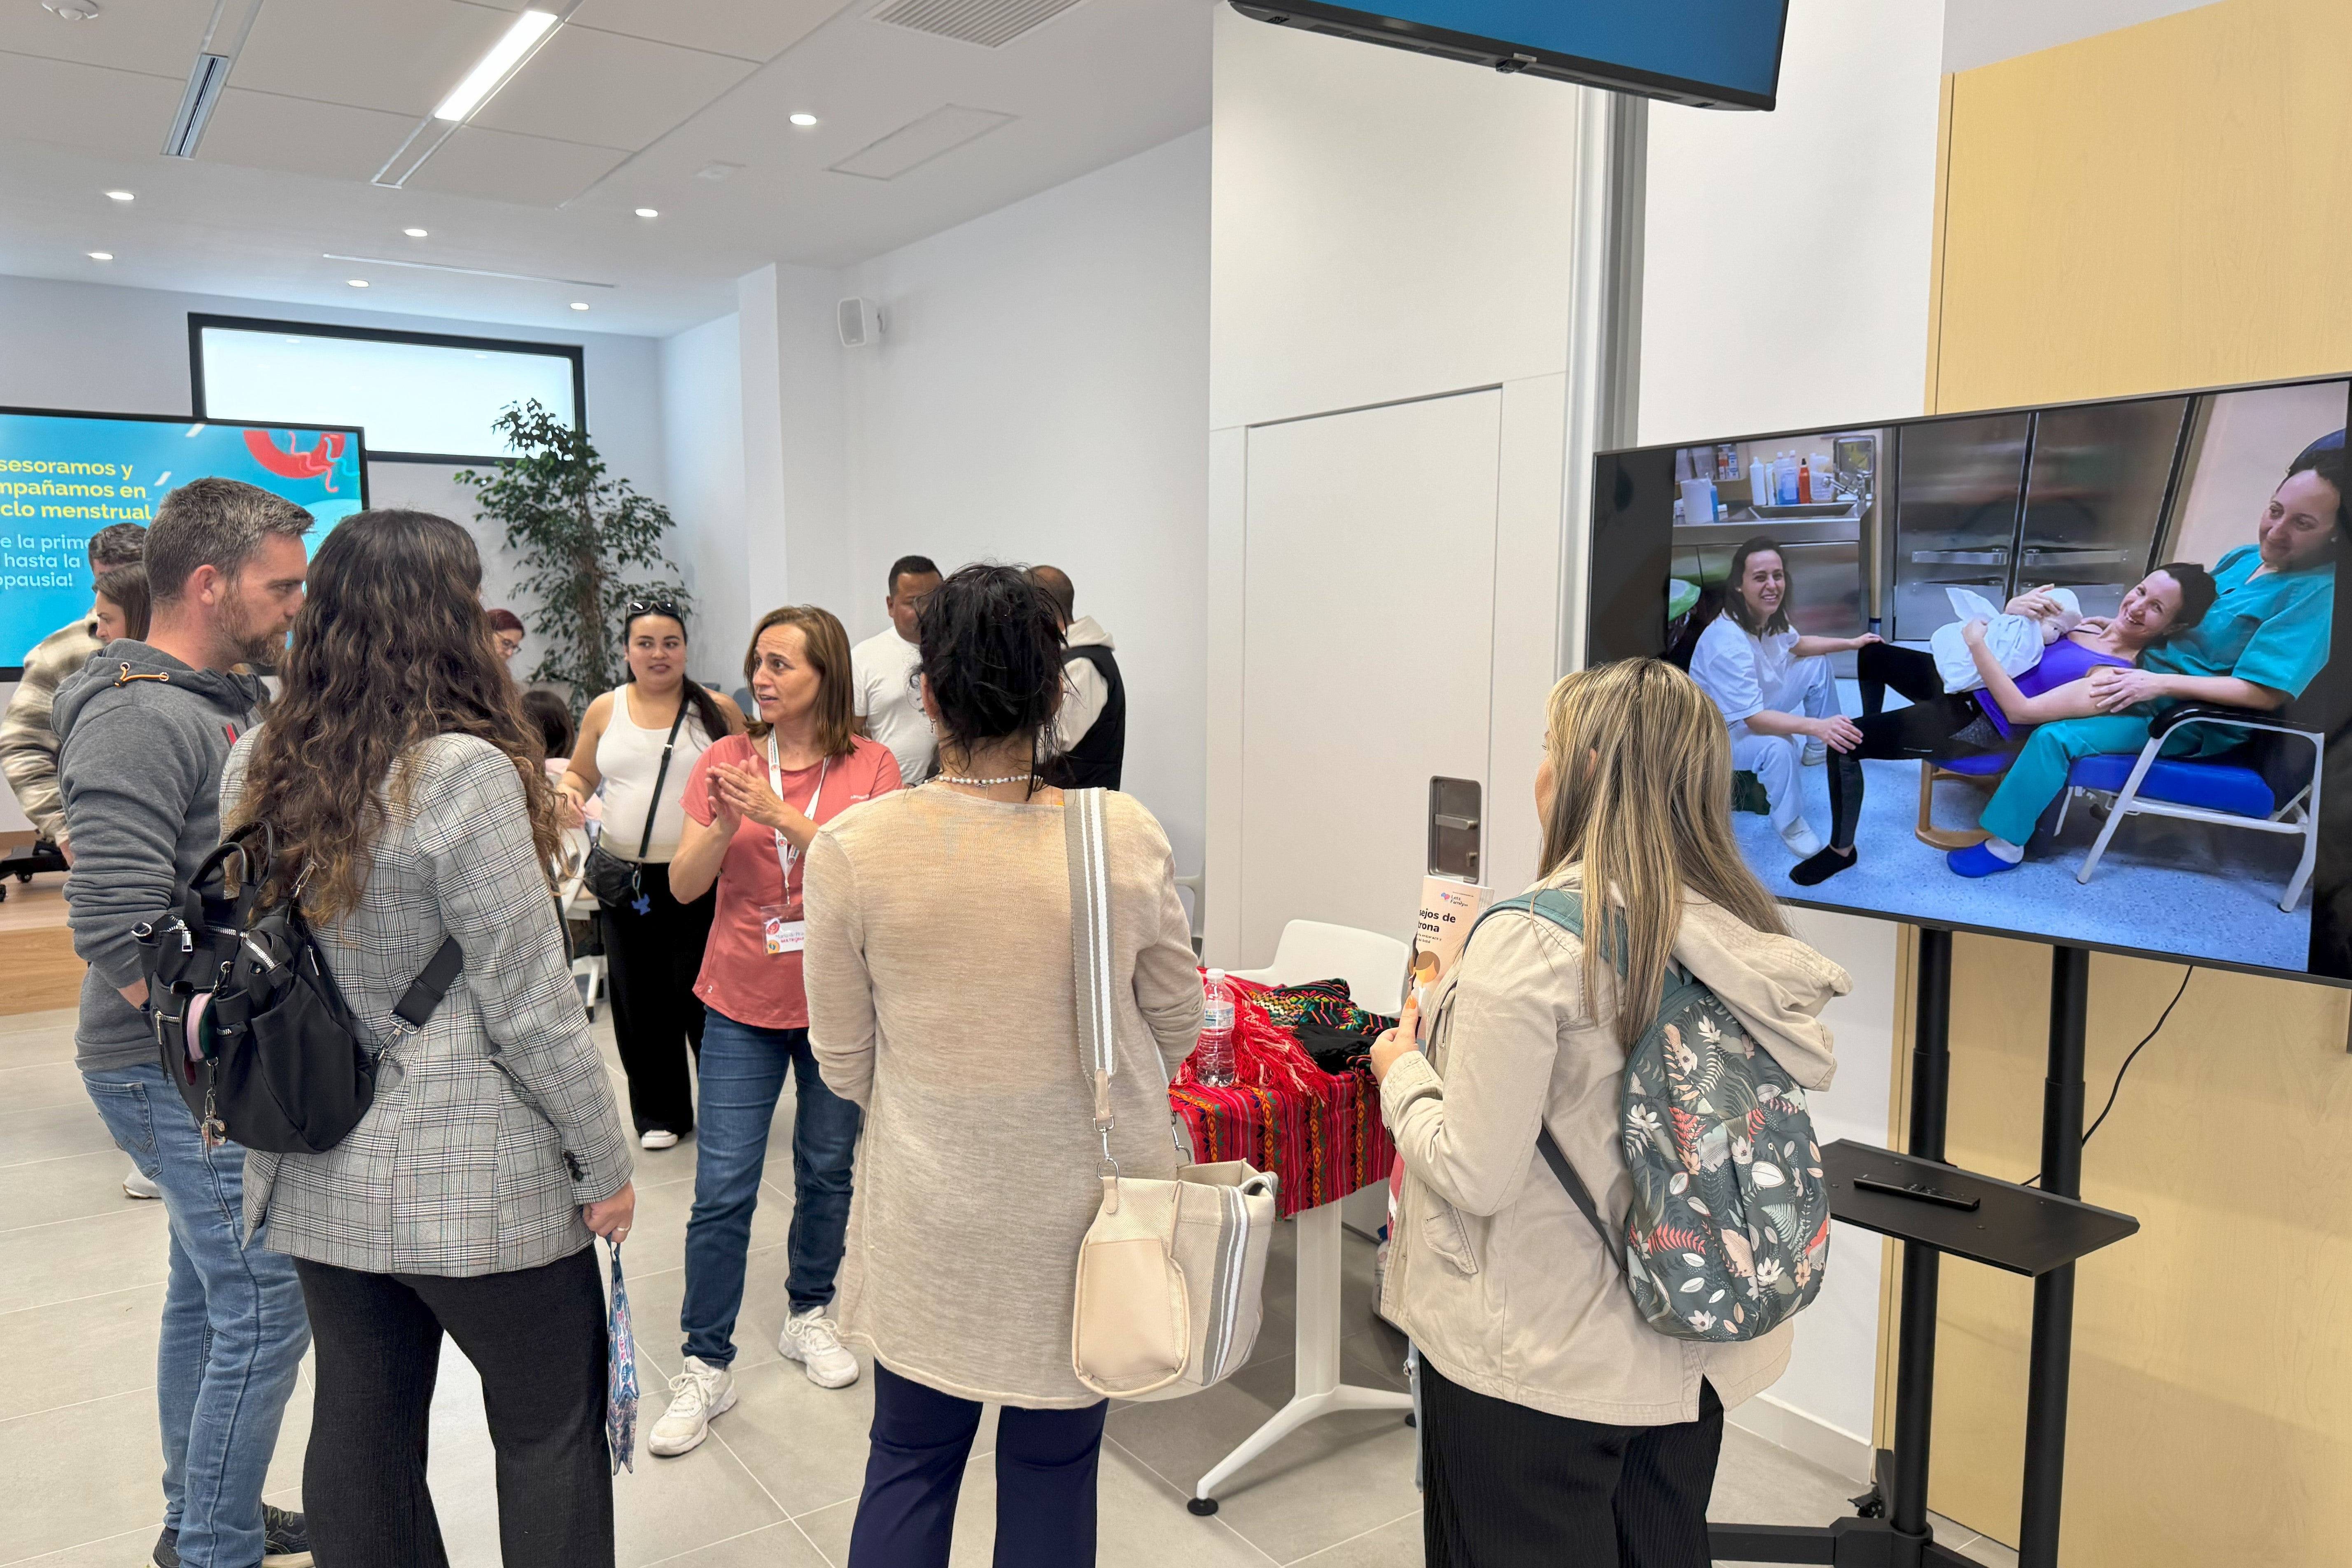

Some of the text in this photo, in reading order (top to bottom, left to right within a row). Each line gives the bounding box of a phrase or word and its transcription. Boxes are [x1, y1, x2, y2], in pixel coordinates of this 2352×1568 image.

[121, 464, 133, 481] y
[120, 485, 146, 498] en
[0, 500, 152, 520] clo menstrual
[18, 534, 35, 549] la
[4, 553, 80, 568] hasta la
[1442, 913, 1456, 923] de
